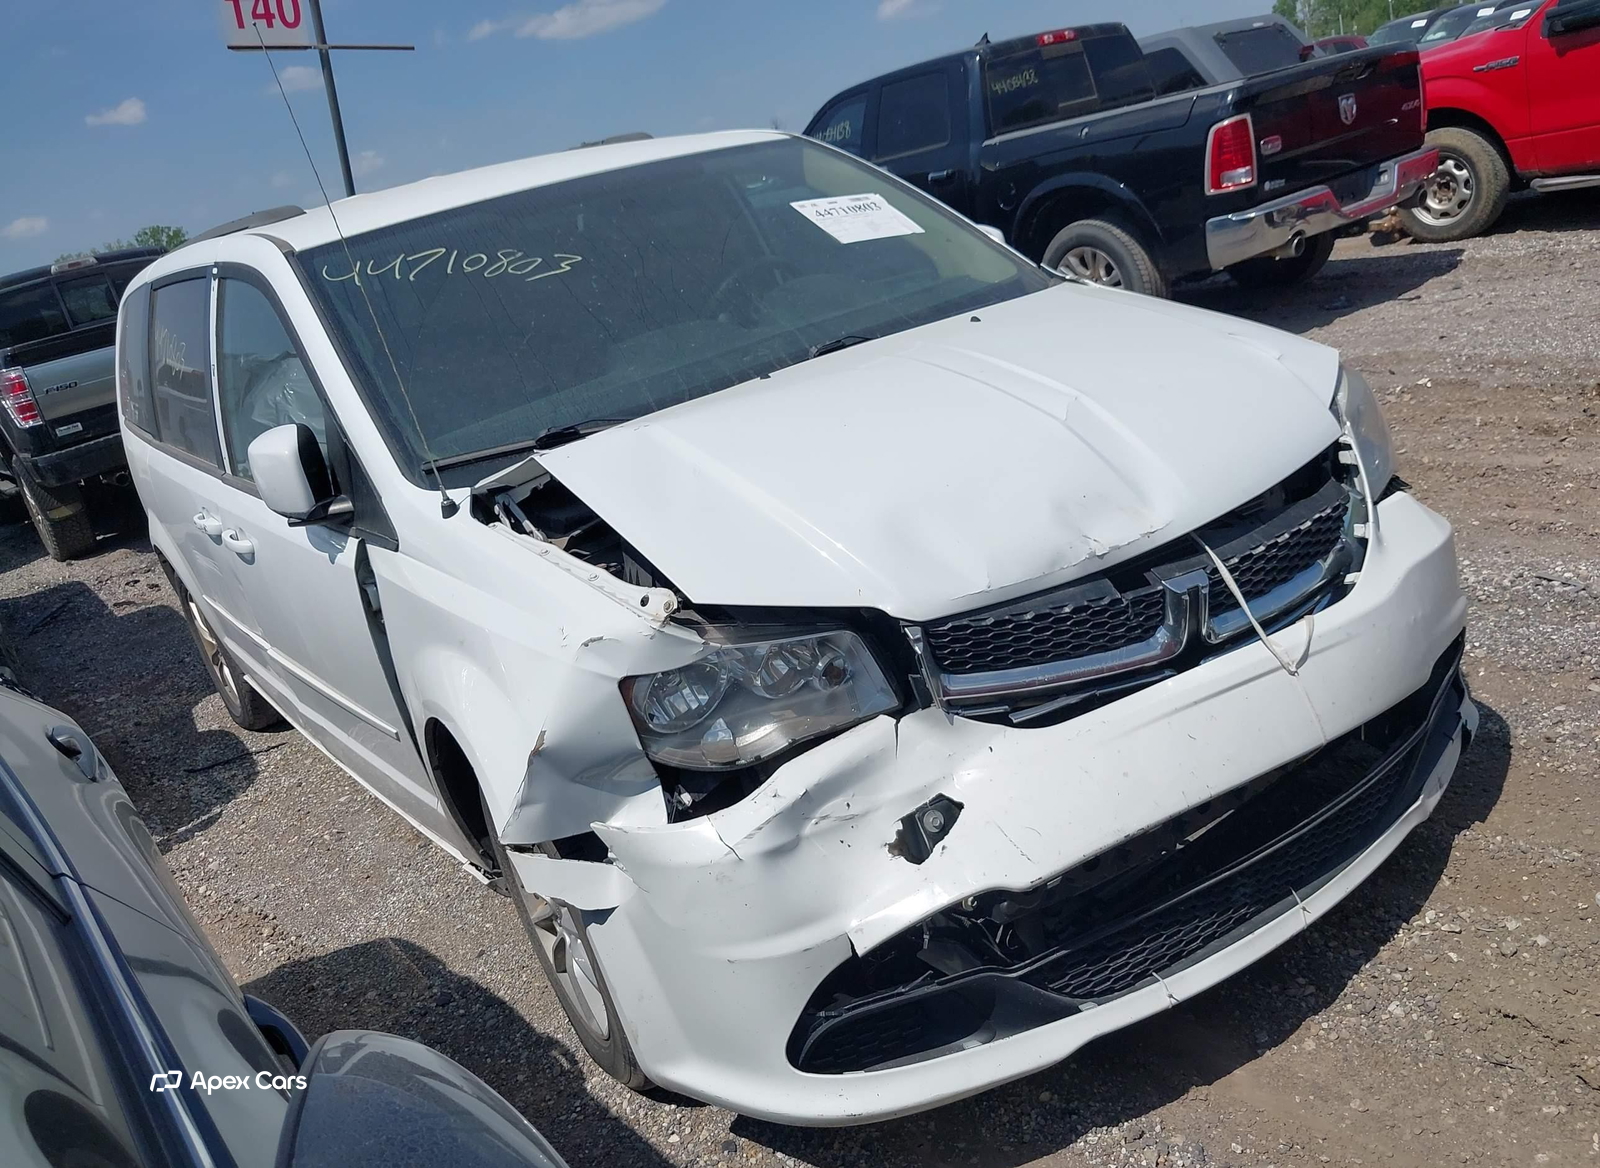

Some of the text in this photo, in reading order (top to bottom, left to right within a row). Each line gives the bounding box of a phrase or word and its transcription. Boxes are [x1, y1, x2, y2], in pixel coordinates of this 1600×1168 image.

[224, 0, 302, 29] 140
[815, 201, 882, 218] 44710803
[322, 247, 583, 286] 44710803
